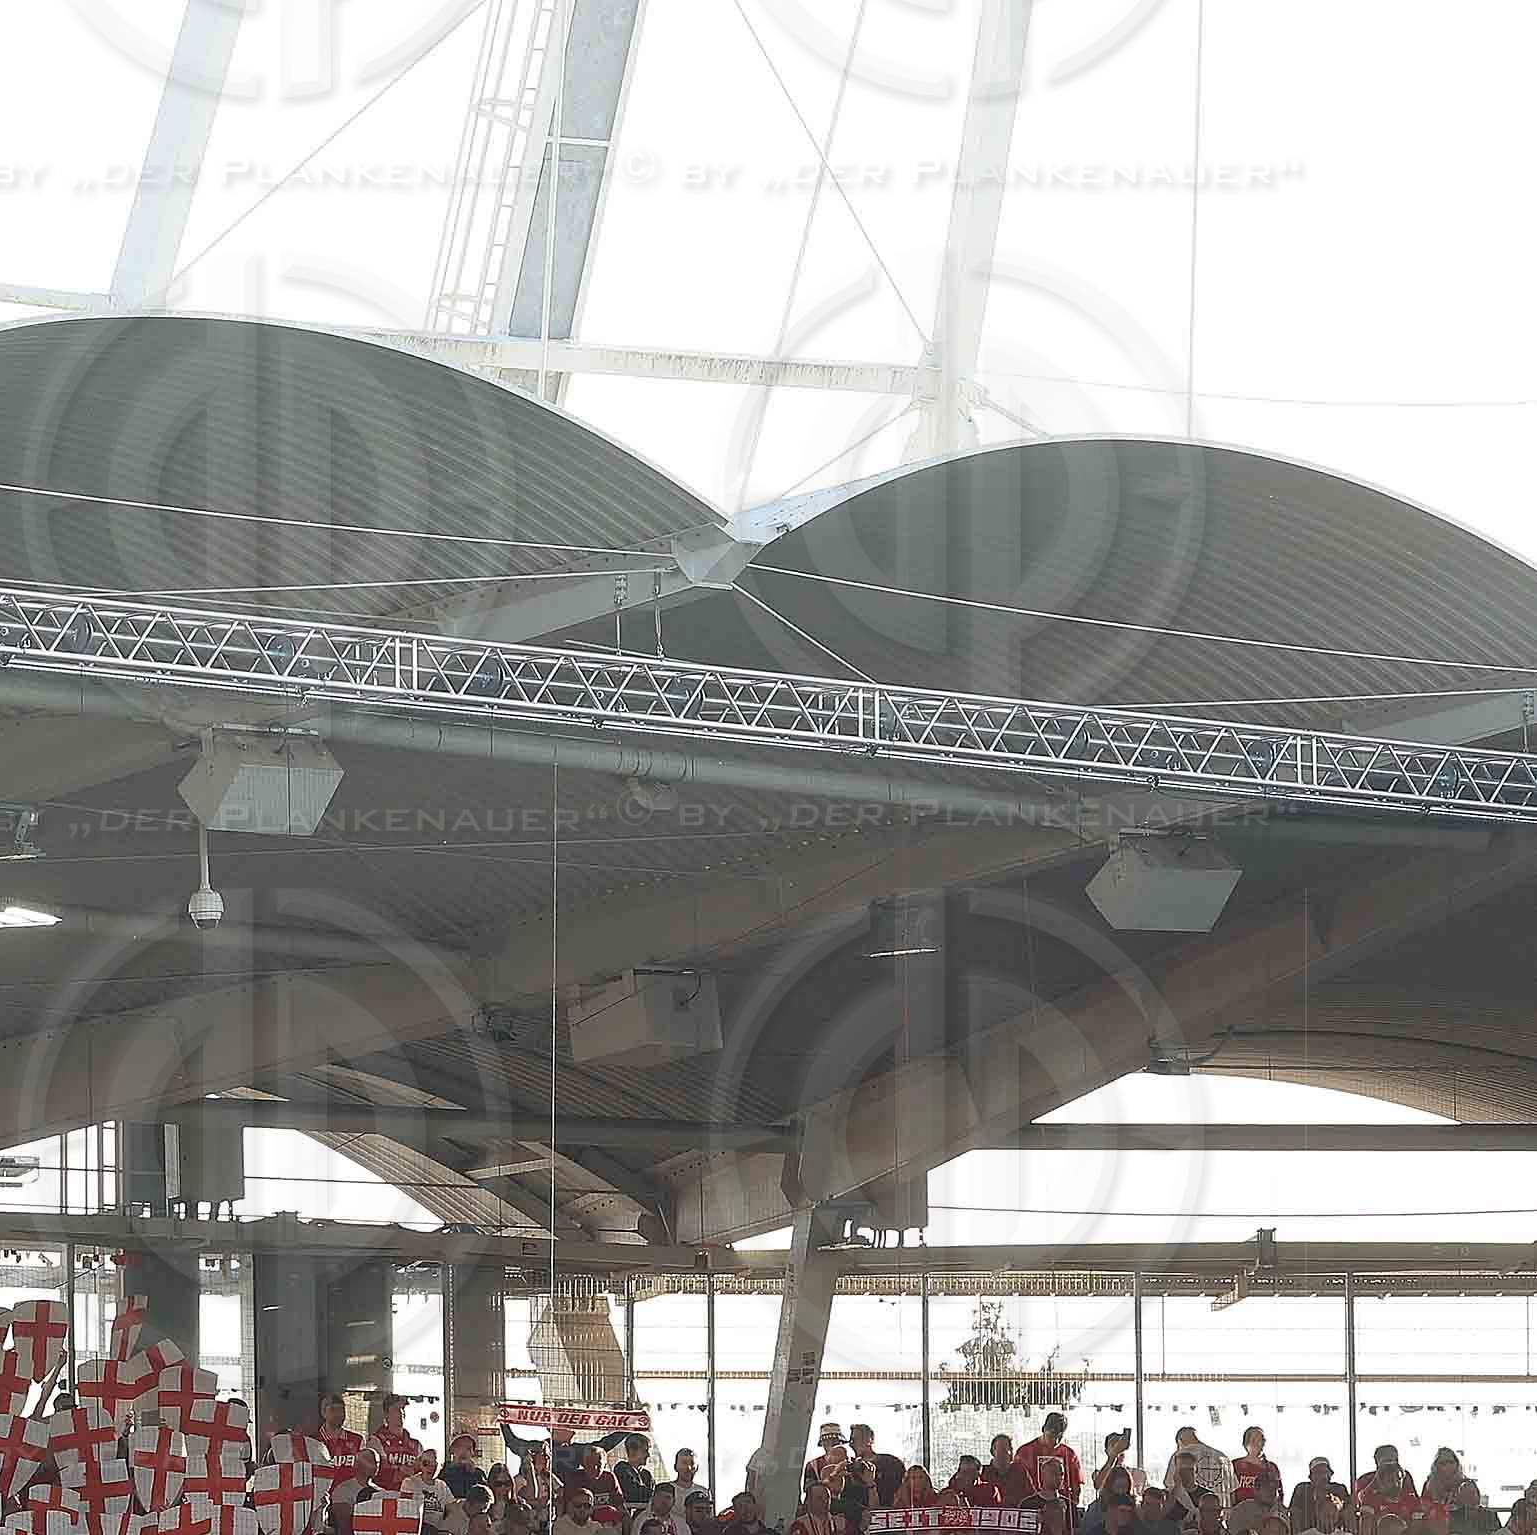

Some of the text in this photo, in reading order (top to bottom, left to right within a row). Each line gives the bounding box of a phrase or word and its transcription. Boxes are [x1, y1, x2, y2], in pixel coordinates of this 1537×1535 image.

[517, 1409, 631, 1428] NUR DER GAK
[870, 1509, 939, 1531] SEIT
